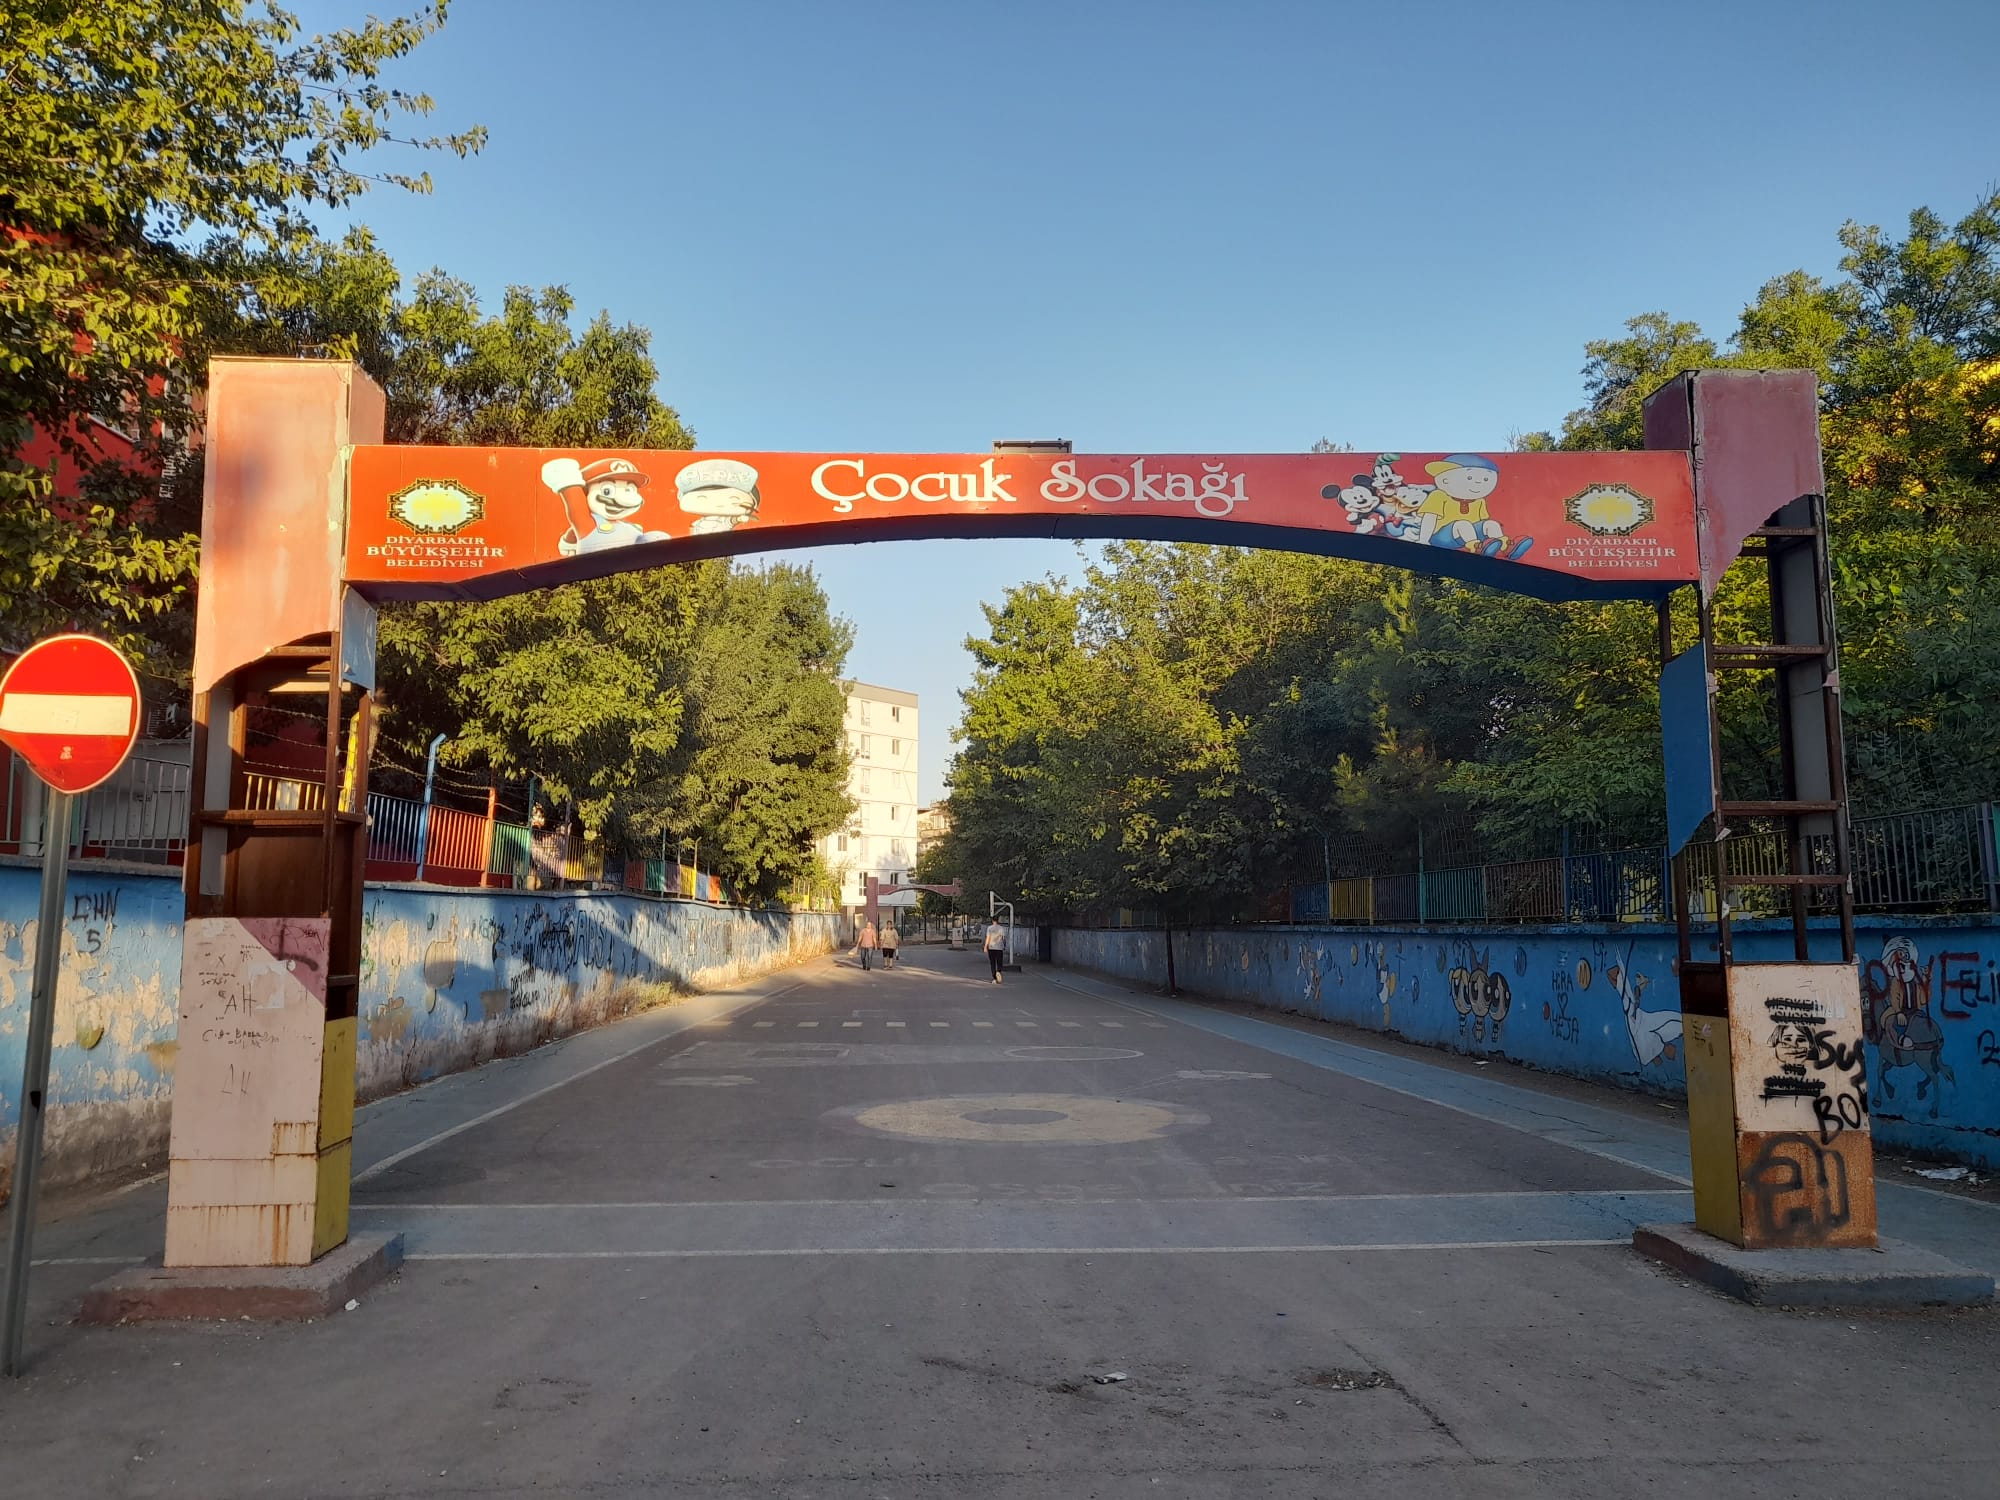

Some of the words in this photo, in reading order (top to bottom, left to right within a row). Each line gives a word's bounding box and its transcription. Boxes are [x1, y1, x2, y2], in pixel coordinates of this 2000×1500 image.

[810, 457, 1017, 513] Çocuk
[1040, 457, 1249, 517] Sokağı
[386, 535, 485, 545] DİYARBAKIR
[1566, 537, 1658, 546] DİYARBAKIR
[366, 544, 505, 559] BÜYÜKŞEHİR
[1548, 545, 1677, 560] BÜYÜKŞEHİR
[386, 558, 484, 568] BELEDİYESİ
[1568, 558, 1658, 568] BELEDİYESİ
